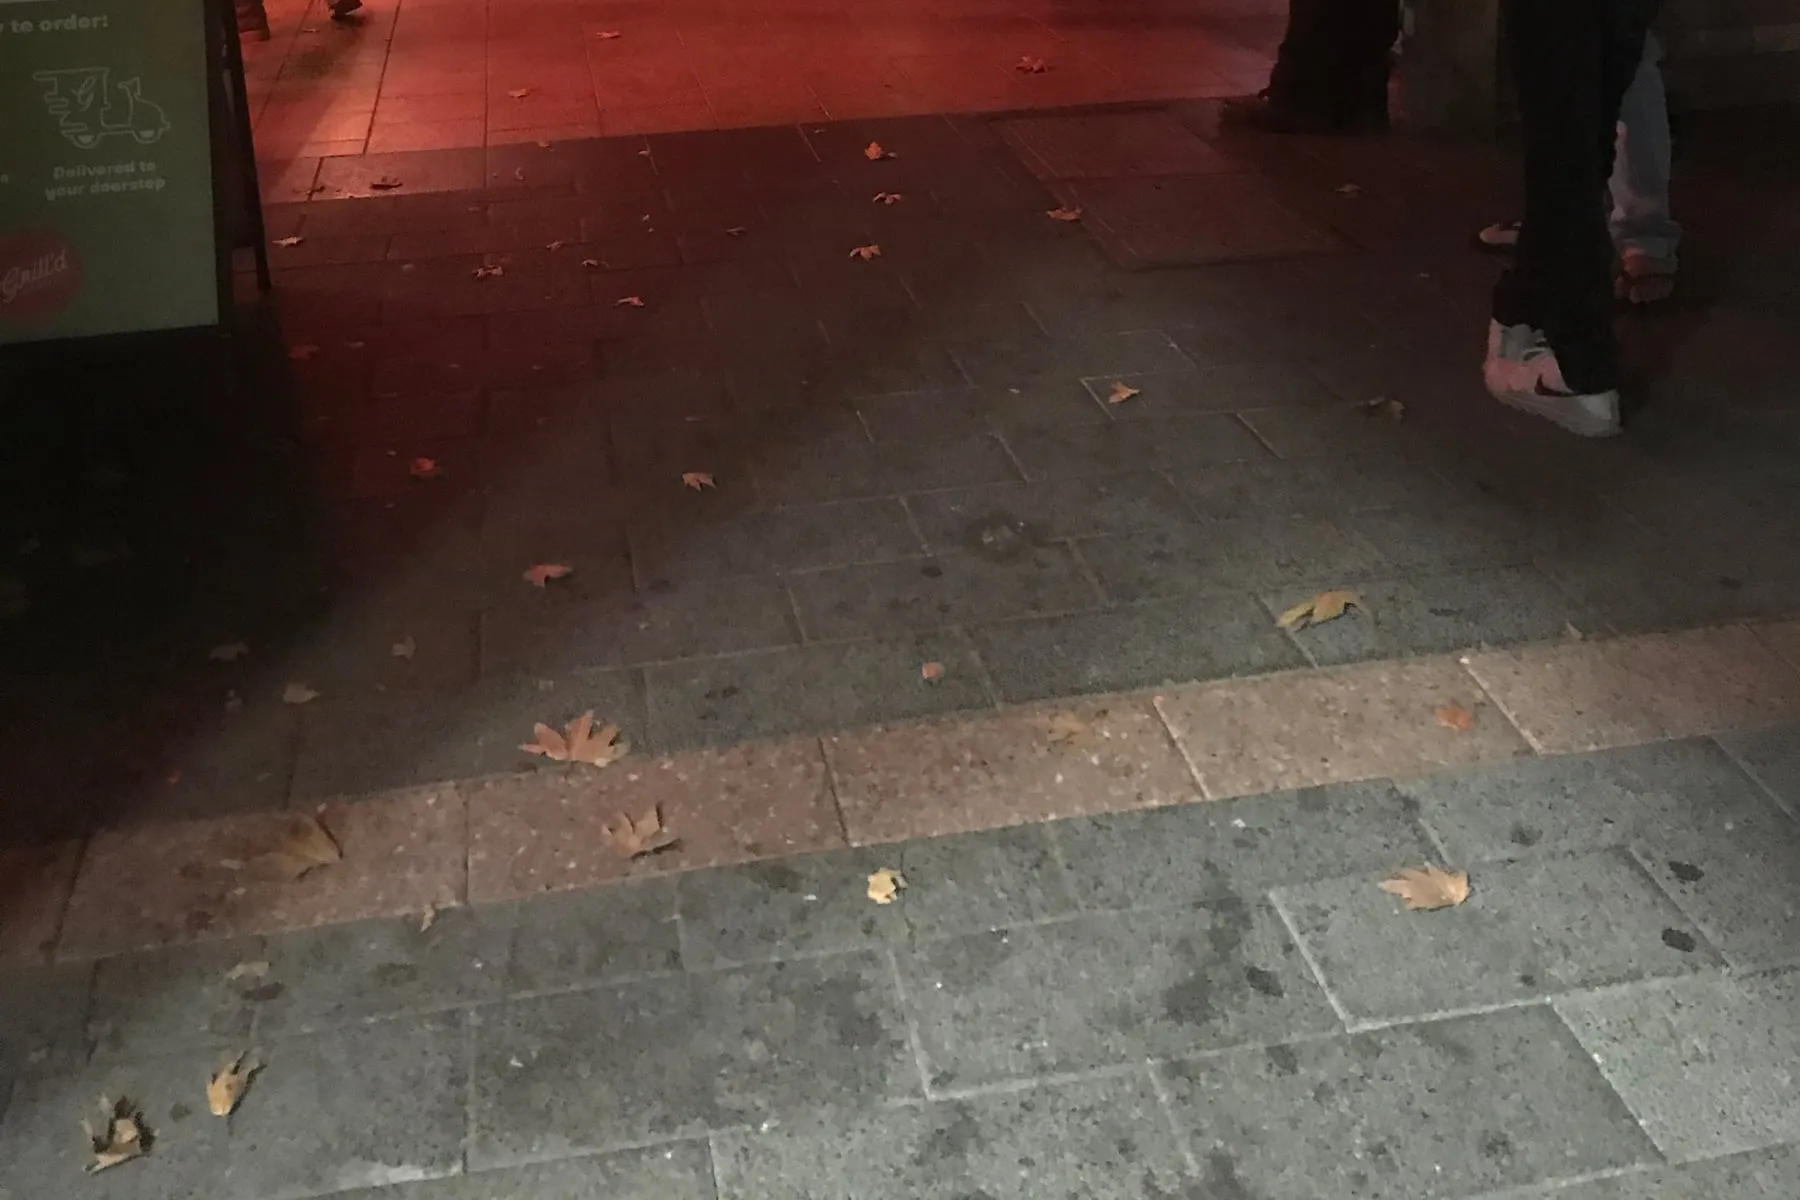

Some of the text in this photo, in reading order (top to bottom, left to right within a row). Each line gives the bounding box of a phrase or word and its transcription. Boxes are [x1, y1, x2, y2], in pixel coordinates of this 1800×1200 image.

[10, 19, 33, 33] to
[38, 13, 109, 32] order:
[54, 160, 156, 179] Delivered to
[45, 178, 166, 201] your doorstep
